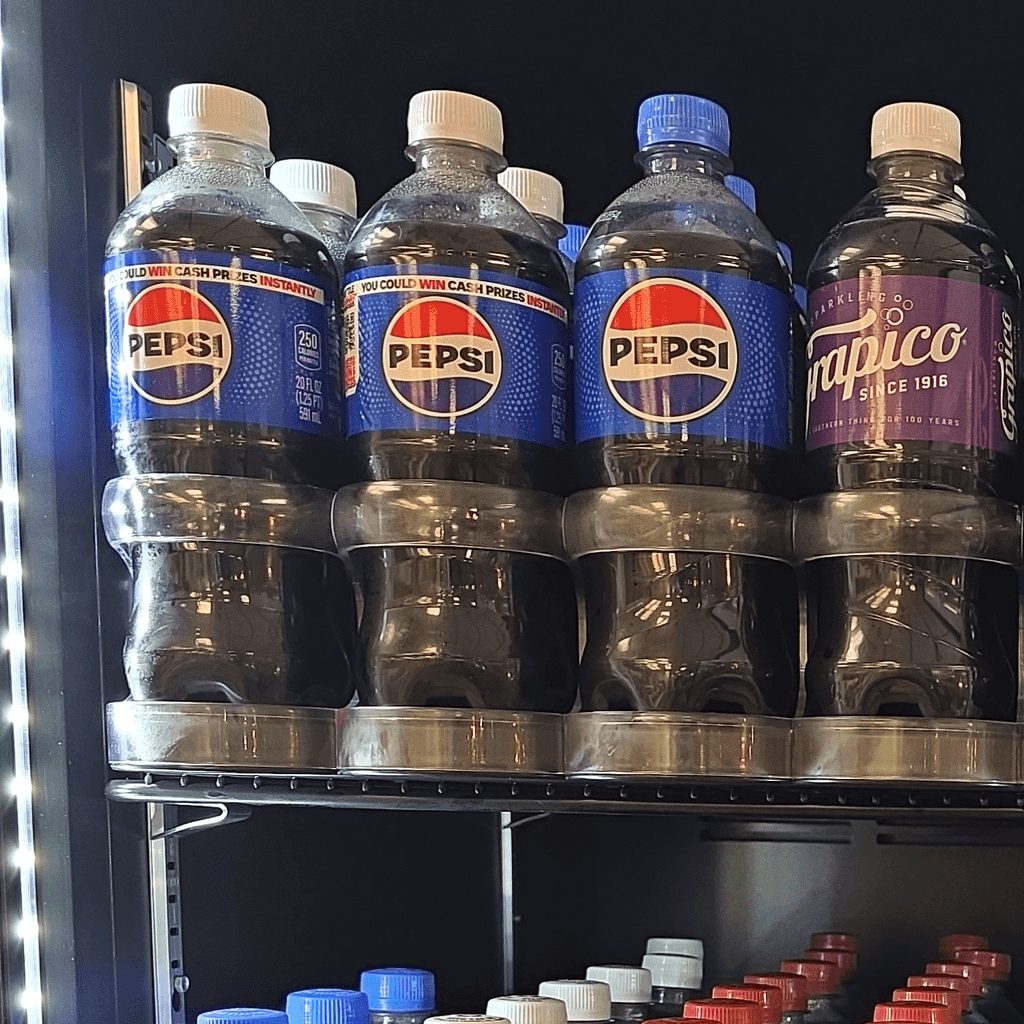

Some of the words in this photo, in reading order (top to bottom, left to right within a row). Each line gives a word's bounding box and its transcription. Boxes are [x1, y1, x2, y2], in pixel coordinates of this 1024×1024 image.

[149, 266, 172, 276] WIN
[176, 266, 210, 278] CASH
[212, 268, 258, 284] PRIZES
[259, 276, 317, 298] INSTANTLY
[361, 281, 378, 292] YOU
[380, 278, 416, 290] COULD
[419, 279, 445, 290] WIN
[448, 281, 483, 294] CASH
[485, 285, 525, 302] PRIZES
[128, 332, 224, 359] PEPSI
[298, 330, 318, 350] 250
[610, 336, 729, 369] PEPSI
[389, 343, 494, 374] PEPSI
[295, 375, 305, 390] 20
[859, 379, 908, 401] SINCE
[915, 374, 948, 390] 1916
[905, 416, 922, 424] 100
[928, 416, 960, 427] YEARS
